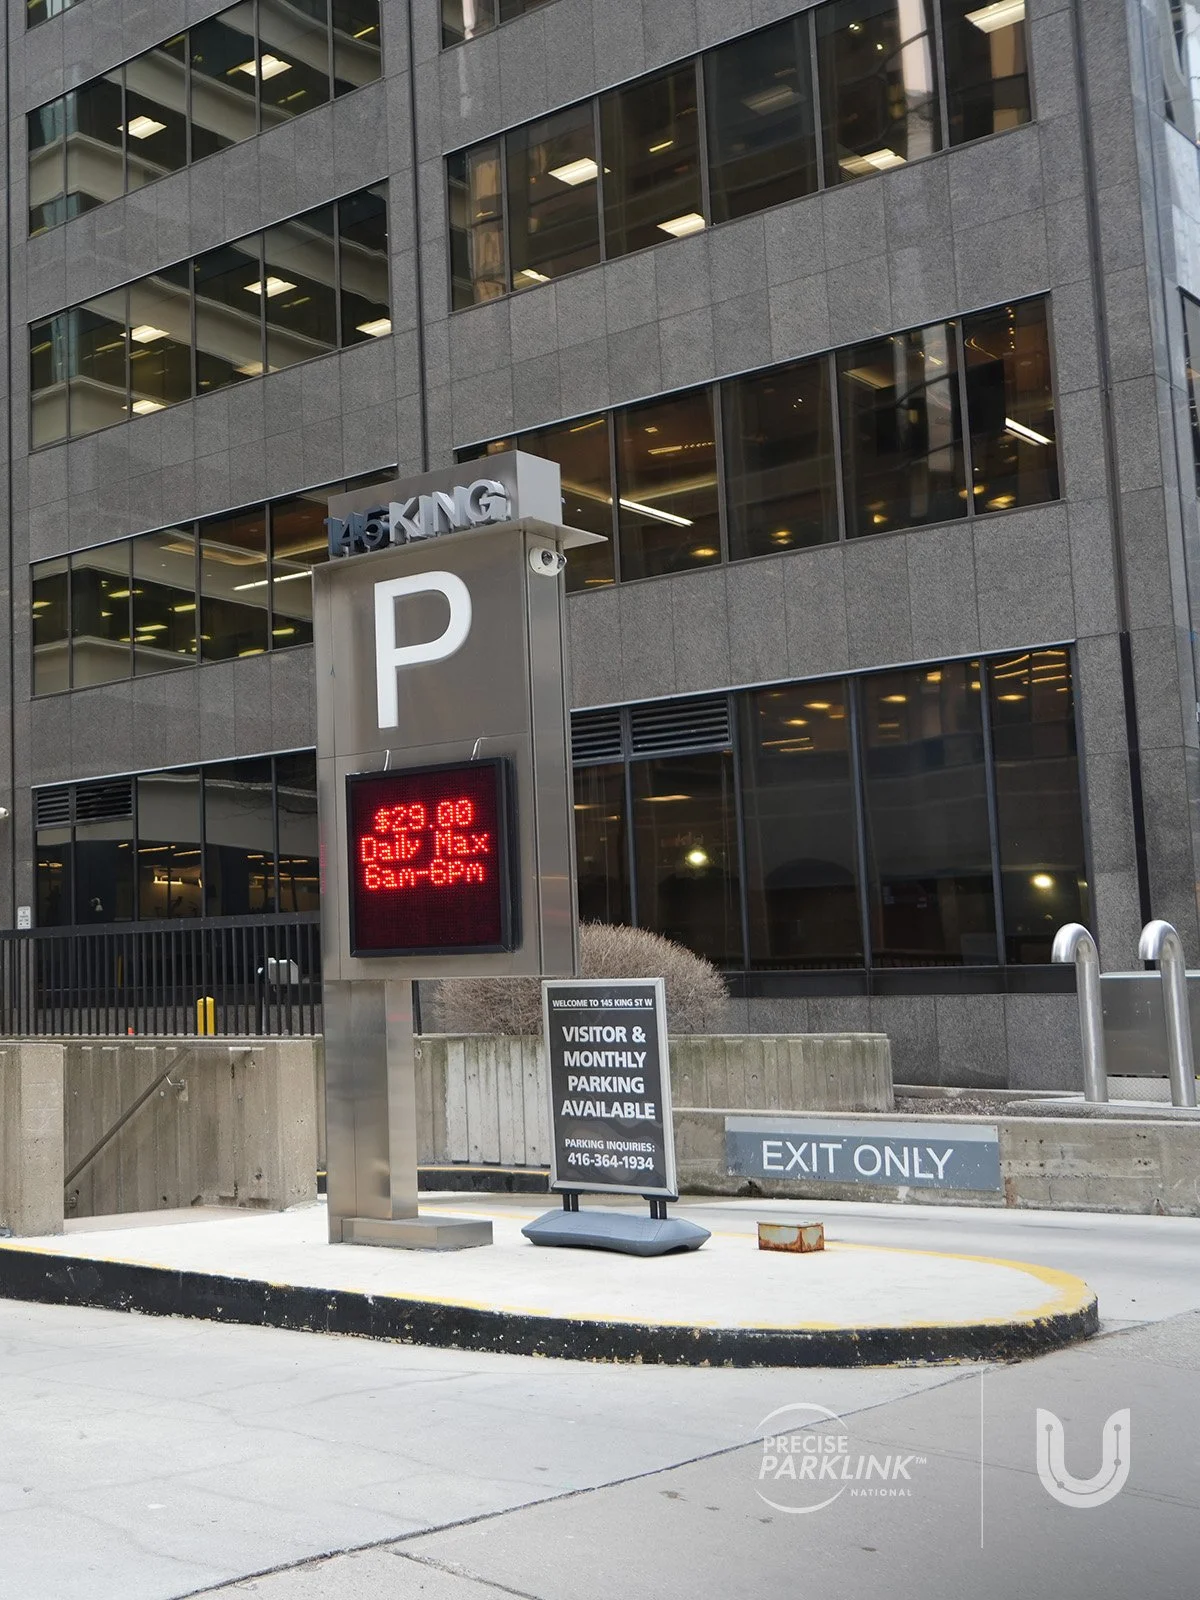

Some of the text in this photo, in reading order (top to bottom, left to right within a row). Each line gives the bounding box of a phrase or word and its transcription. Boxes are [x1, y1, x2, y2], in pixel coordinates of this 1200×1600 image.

[389, 479, 511, 546] KING
[374, 570, 473, 730] P
[374, 798, 473, 833] $29.00
[361, 829, 489, 862] Daily Max
[552, 998, 653, 1008] WELCOME TO 145 KING ST W
[562, 1026, 646, 1043] VISITOR &
[563, 1051, 647, 1069] MONTHLY
[568, 1075, 645, 1094] PARKING
[561, 1100, 656, 1120] AVAILABLE
[565, 1138, 655, 1152] PARKING INQUIRIES:
[567, 1152, 655, 1171] 416-364-1934
[762, 1140, 954, 1180] EXIT ONLY
